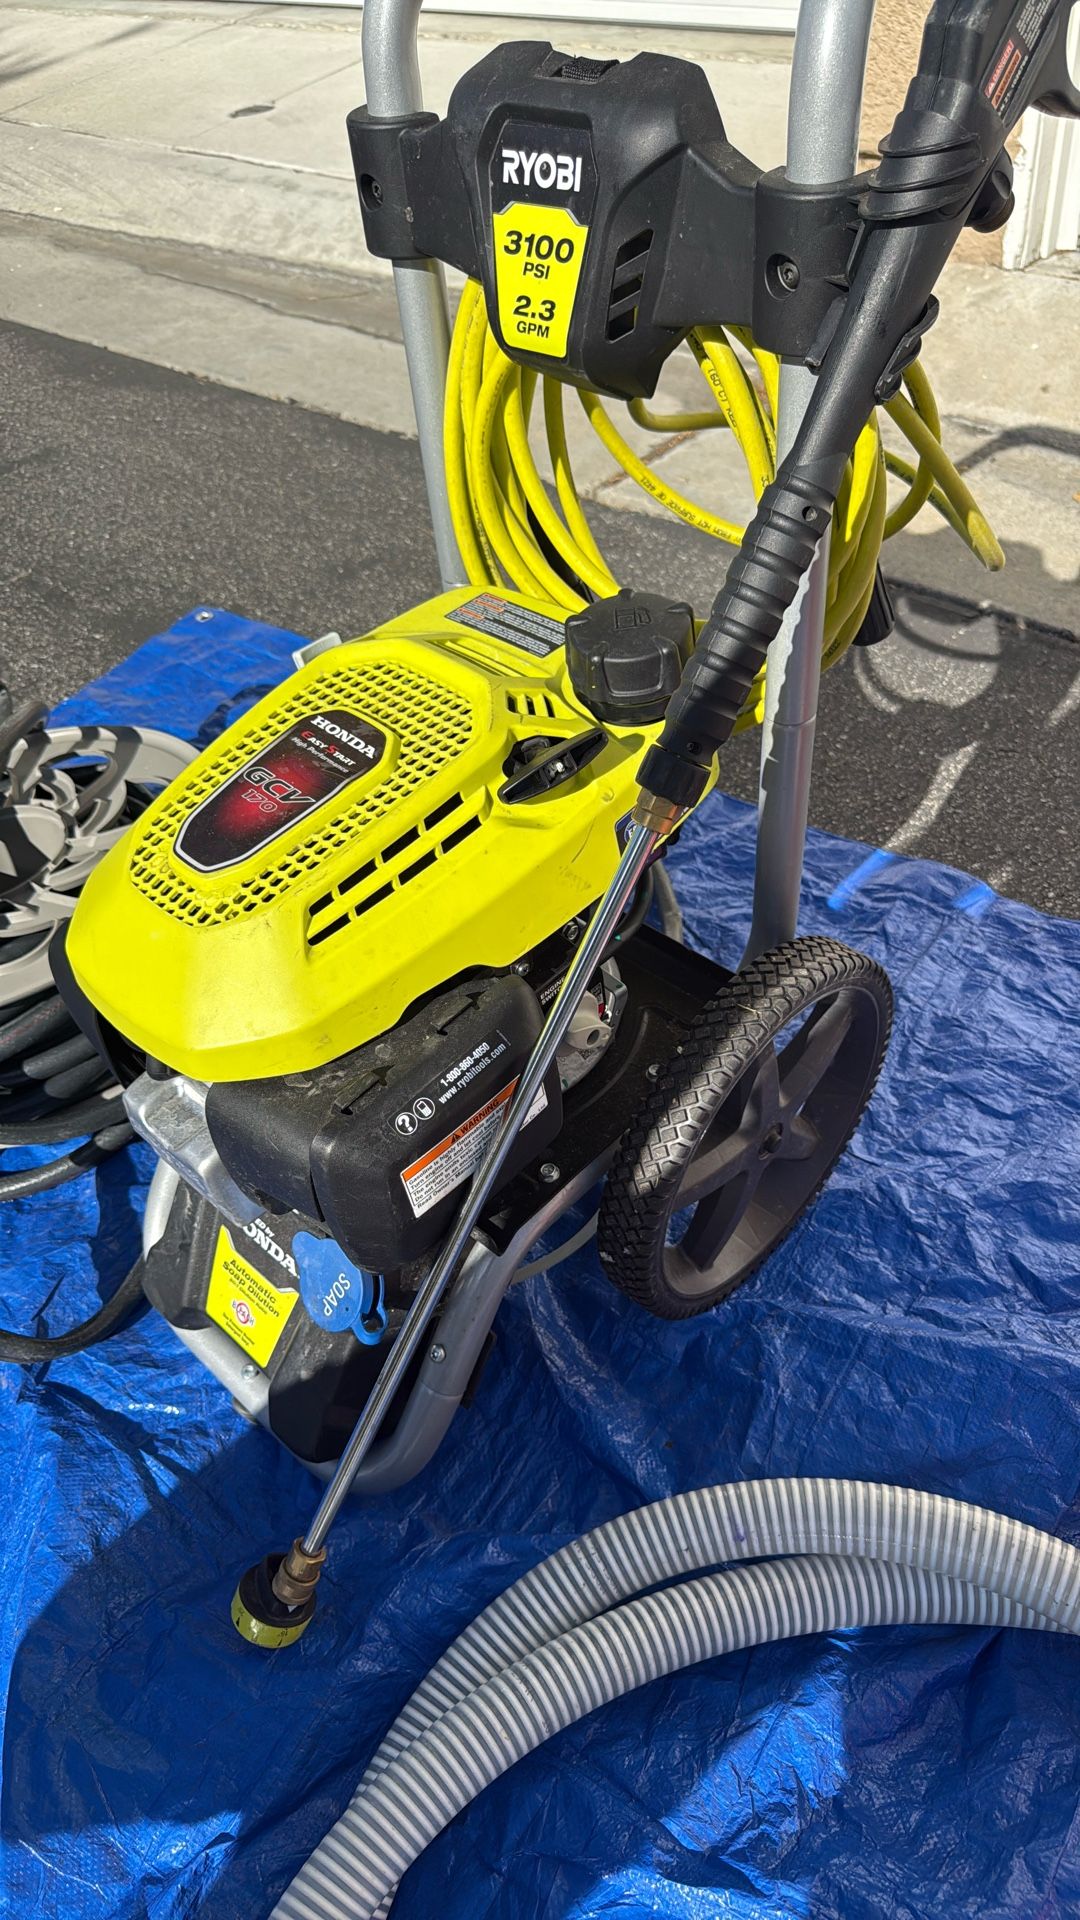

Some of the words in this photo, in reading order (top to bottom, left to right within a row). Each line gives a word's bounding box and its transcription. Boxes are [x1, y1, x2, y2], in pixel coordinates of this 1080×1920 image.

[502, 149, 582, 192] RYOBI
[504, 230, 574, 264] 3100
[522, 262, 550, 279] PSI
[513, 295, 556, 321] 2.3
[516, 321, 550, 338] GPM
[301, 730, 328, 748] EASY
[325, 744, 356, 766] START
[310, 715, 375, 758] HONDA
[291, 737, 308, 748] High
[306, 746, 349, 773] Performance
[241, 788, 278, 812] 170
[243, 767, 316, 804] GCV
[541, 987, 561, 1006] SWITC
[439, 1042, 506, 1104] www.ryobitools.com
[440, 1042, 490, 1087] 1-800-860-4050
[460, 1098, 500, 1133] WARNING
[409, 1165, 433, 1185] Gasoline
[440, 1147, 456, 1160] highly
[411, 1179, 423, 1190] Turn
[425, 1163, 443, 1179] engine
[414, 1186, 424, 1196] The
[425, 1172, 444, 1188] engine
[415, 1194, 423, 1202] Do
[417, 1195, 432, 1208] Read
[433, 1178, 454, 1196] Owner's
[254, 1218, 266, 1230] ED
[243, 1223, 299, 1278] ONDA
[222, 1261, 246, 1286] Soap
[248, 1286, 279, 1317] Dilution
[230, 1260, 276, 1304] Automatic
[323, 1272, 350, 1316] SOAP
